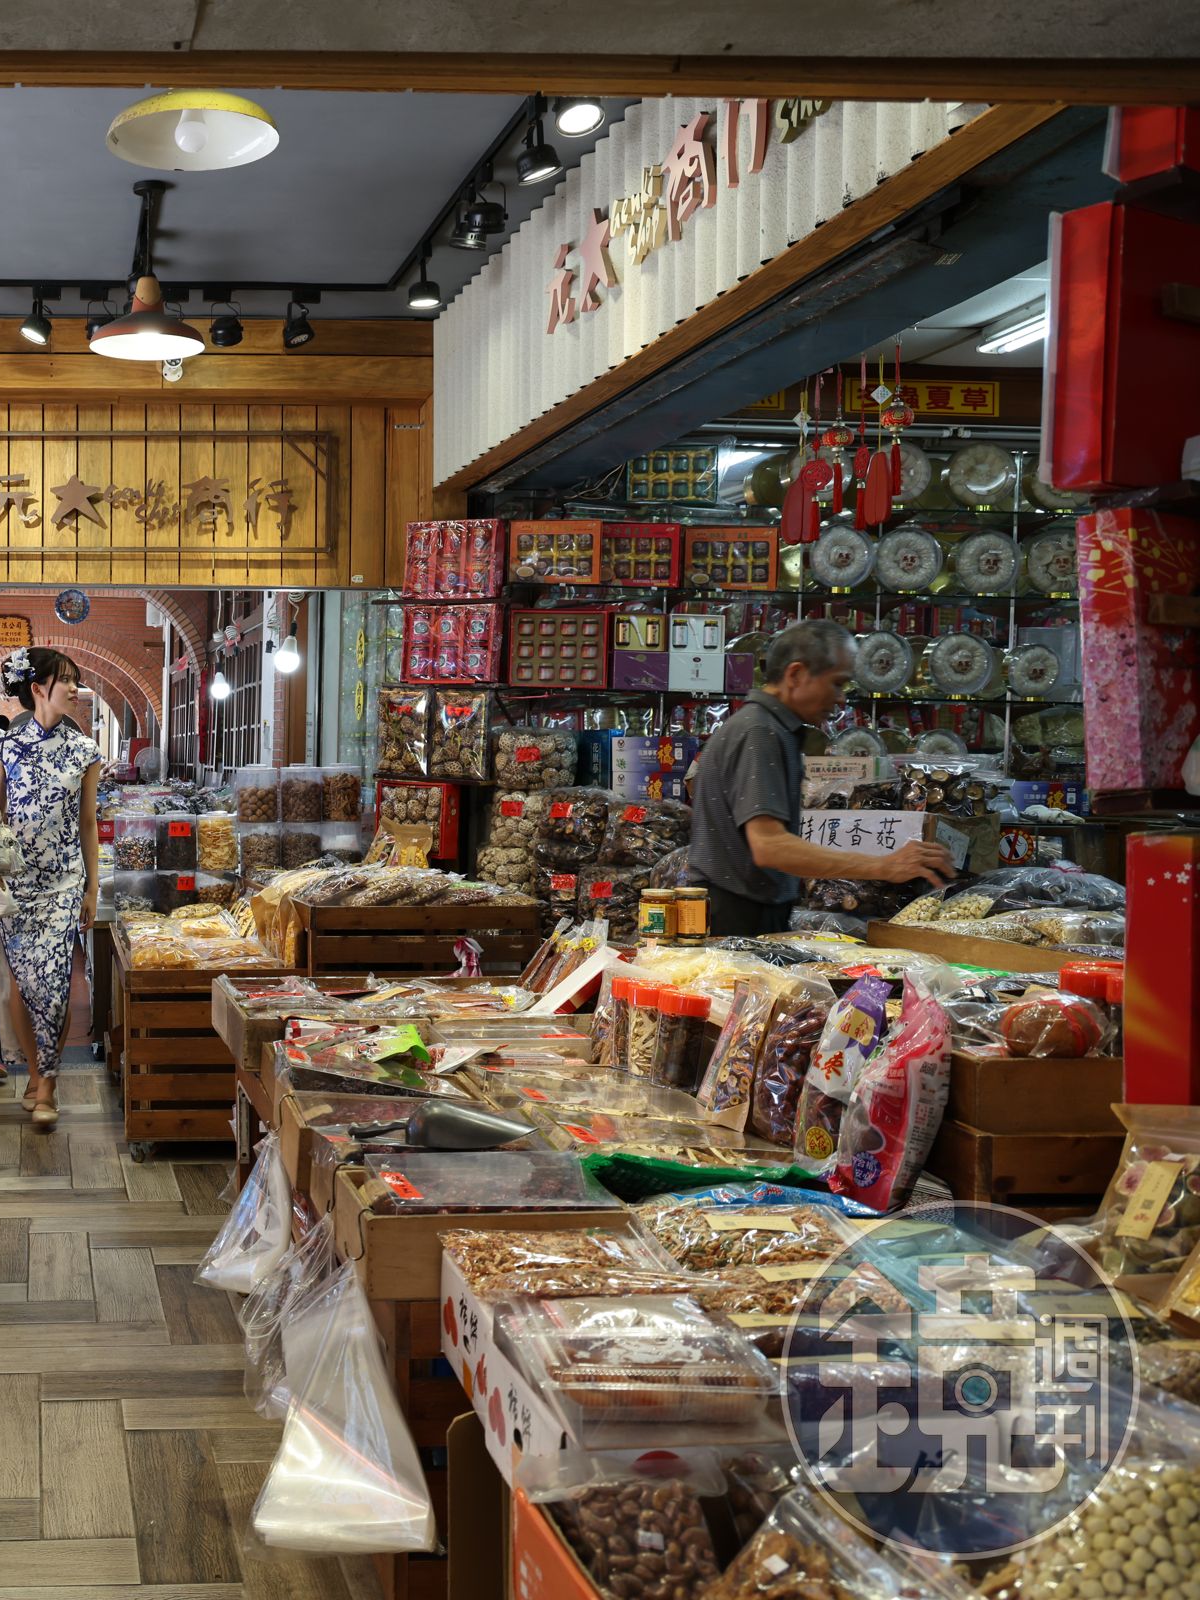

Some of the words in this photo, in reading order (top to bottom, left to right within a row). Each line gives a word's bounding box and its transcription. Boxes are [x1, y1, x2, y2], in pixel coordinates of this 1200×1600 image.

[626, 205, 668, 266] Shop
[182, 475, 295, 540] 商行
[800, 815, 903, 850] 特價香菇
